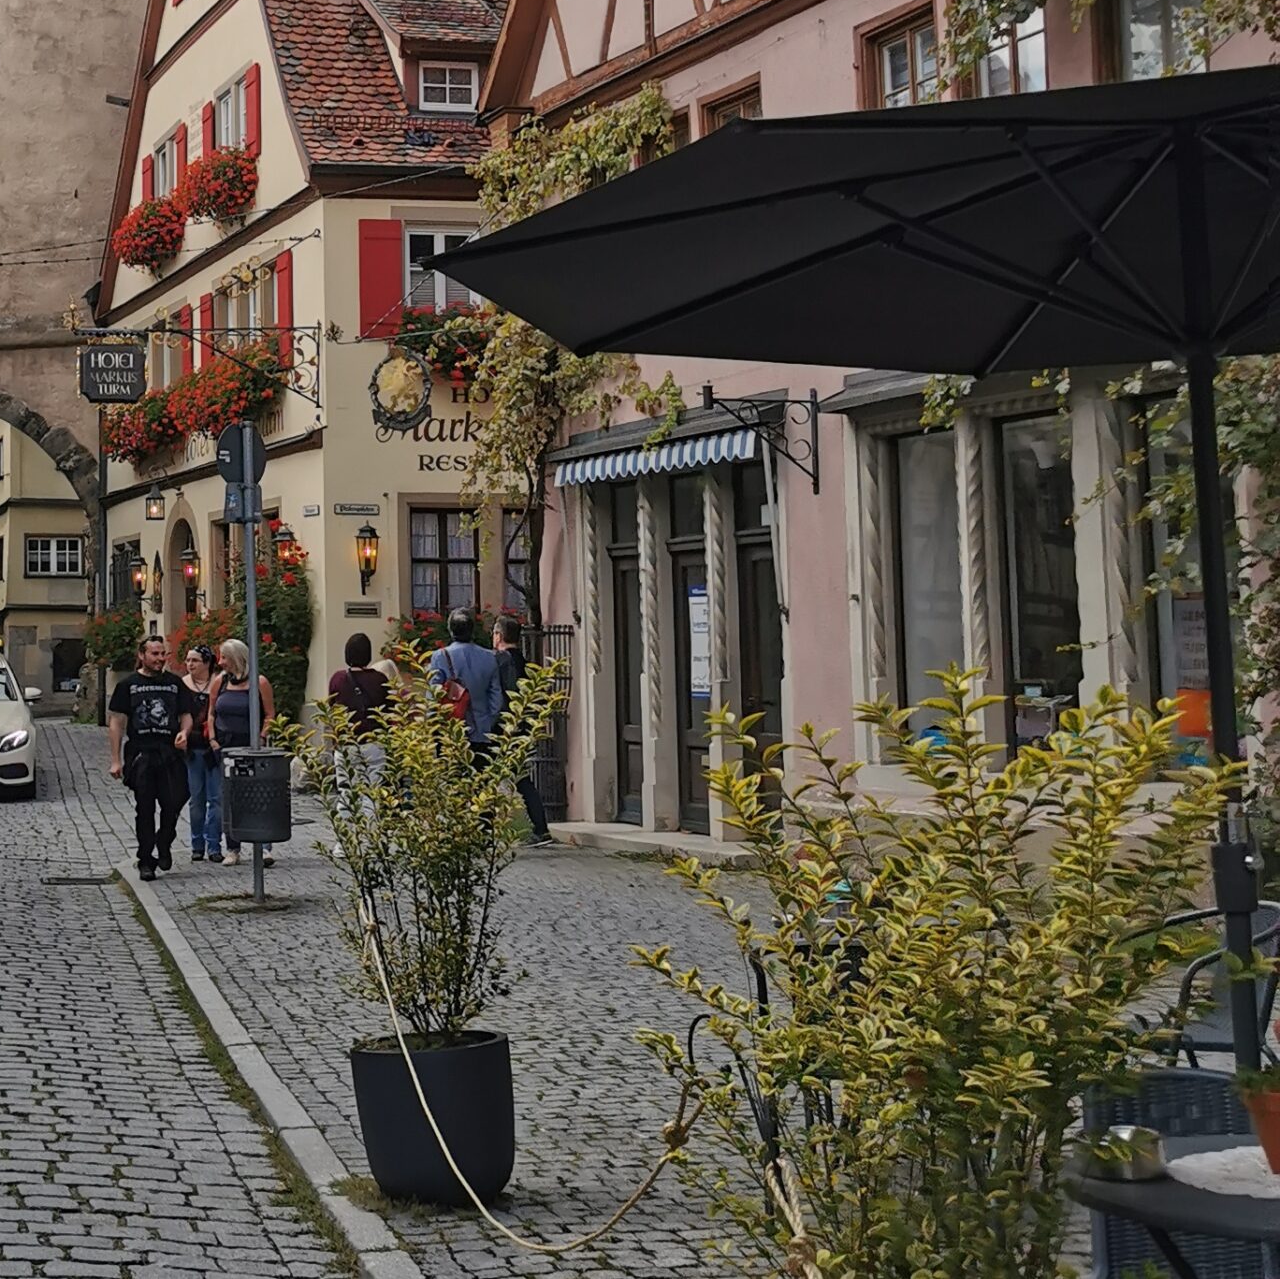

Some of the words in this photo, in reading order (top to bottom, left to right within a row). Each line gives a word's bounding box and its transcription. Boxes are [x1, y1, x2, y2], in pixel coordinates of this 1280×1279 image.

[91, 352, 134, 369] HOTEL
[90, 371, 138, 383] MARKUS
[97, 384, 131, 395] TURM
[451, 386, 494, 404] HO
[418, 454, 473, 471] RES
